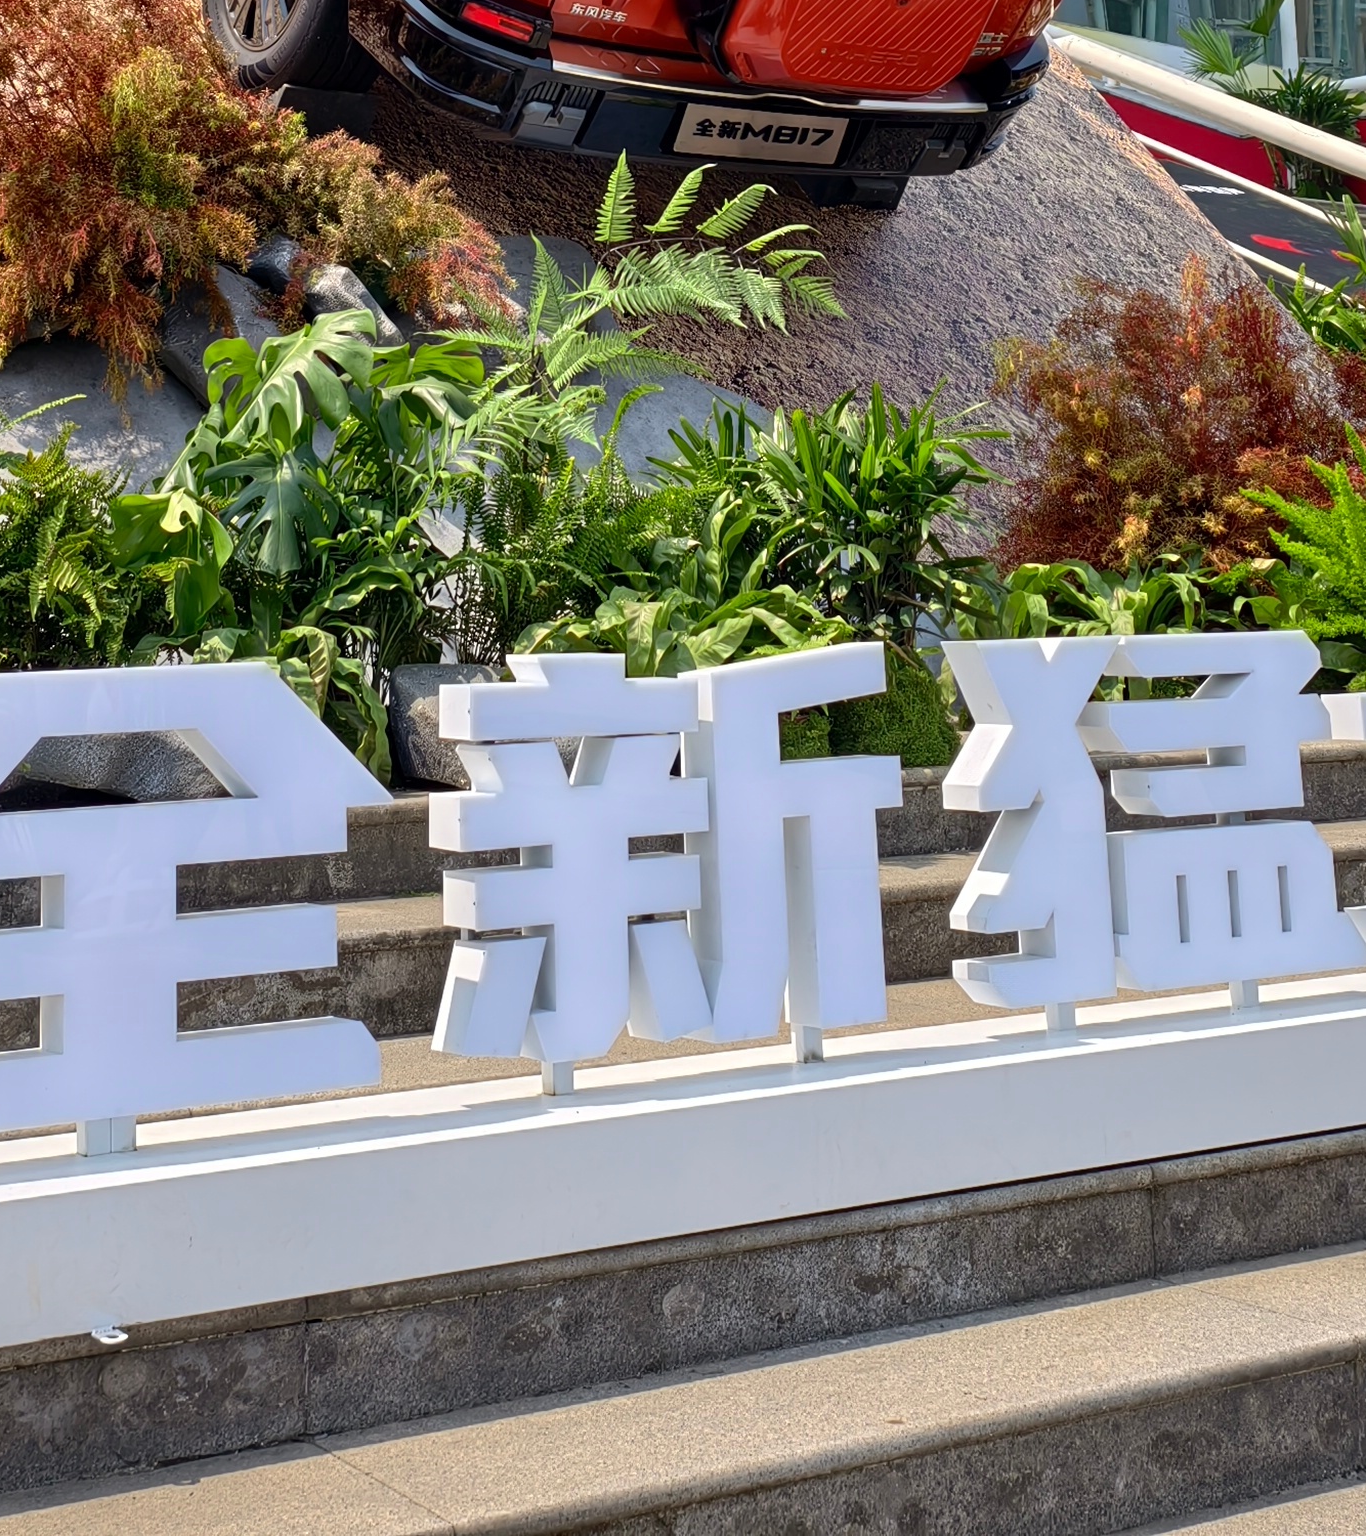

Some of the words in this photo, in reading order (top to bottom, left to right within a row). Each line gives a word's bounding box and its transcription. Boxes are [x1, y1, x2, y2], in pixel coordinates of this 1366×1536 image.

[569, 2, 628, 22] 东风汽车
[692, 118, 834, 146] 全新M817
